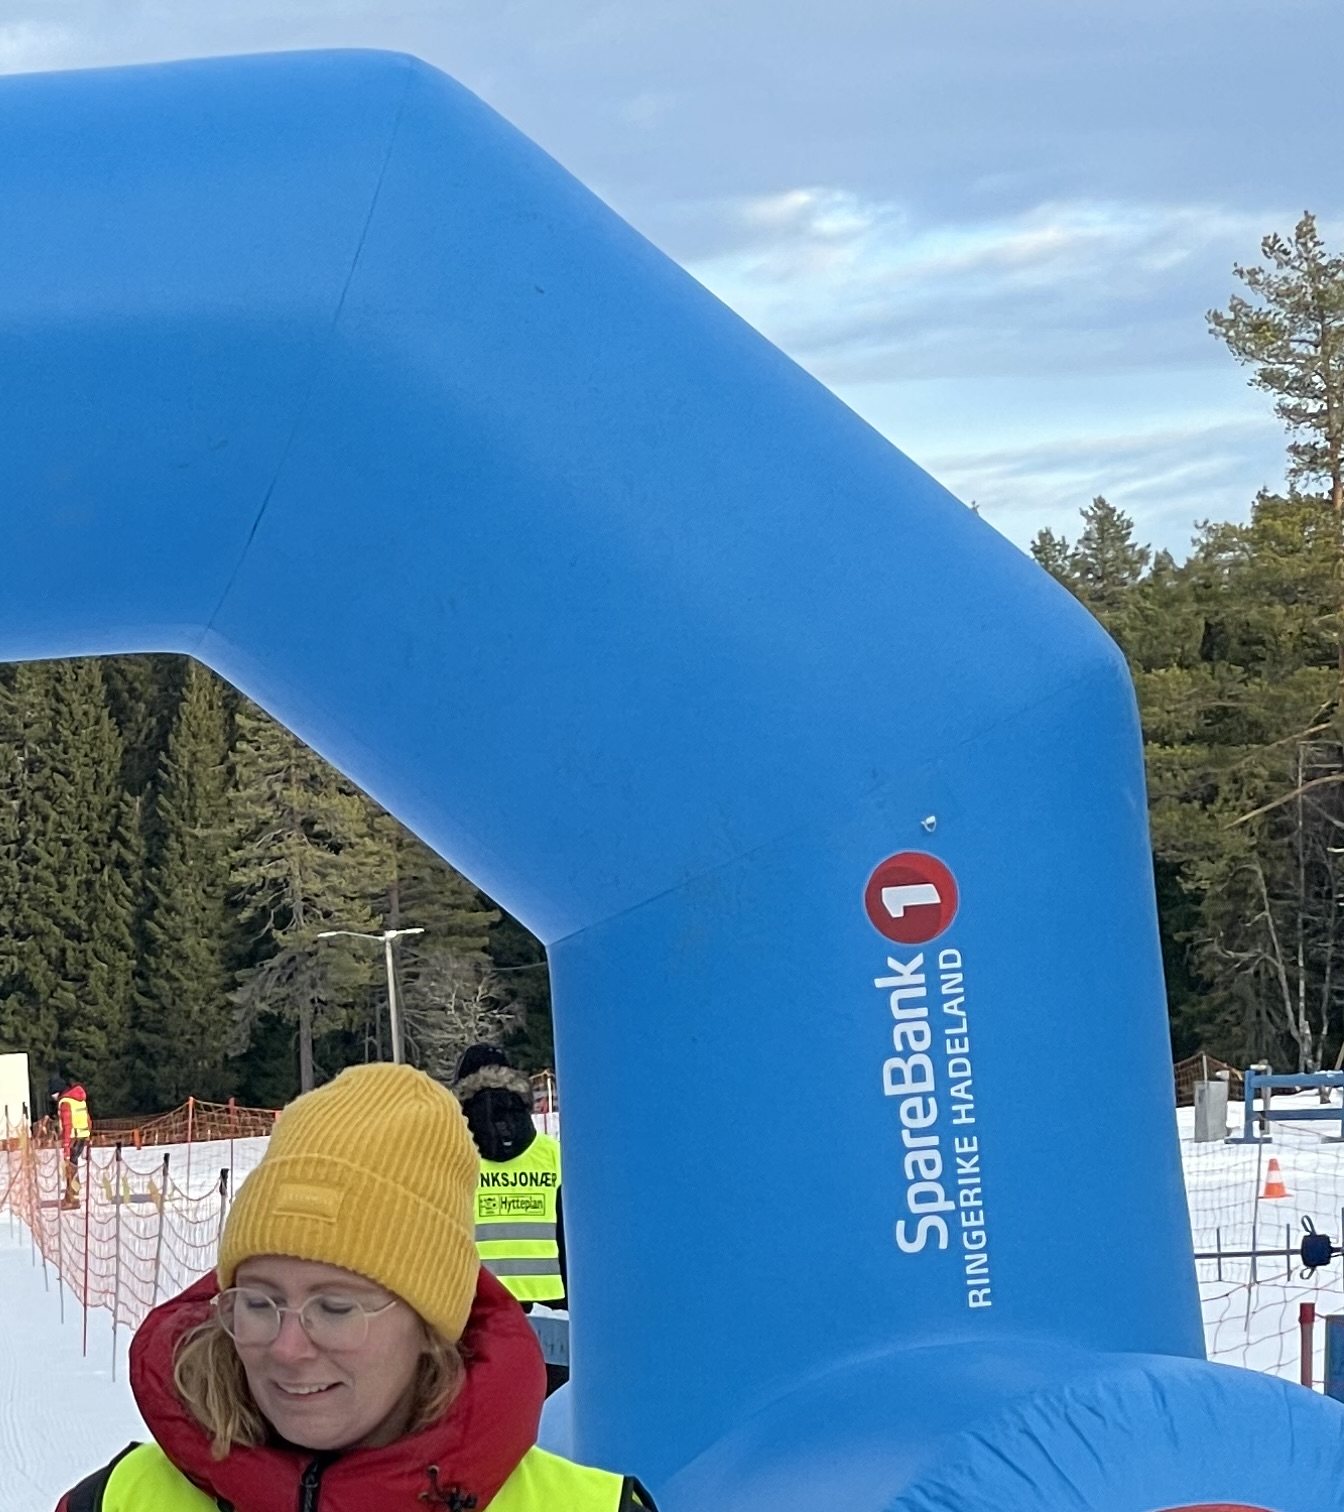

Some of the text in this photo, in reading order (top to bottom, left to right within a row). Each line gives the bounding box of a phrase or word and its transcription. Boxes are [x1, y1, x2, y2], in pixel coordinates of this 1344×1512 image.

[874, 883, 955, 1254] SpareBank 1
[938, 947, 993, 1308] RINGERIKE HADELAND
[479, 1172, 557, 1188] NKSJONÆR
[500, 1195, 544, 1214] Hytteplan
